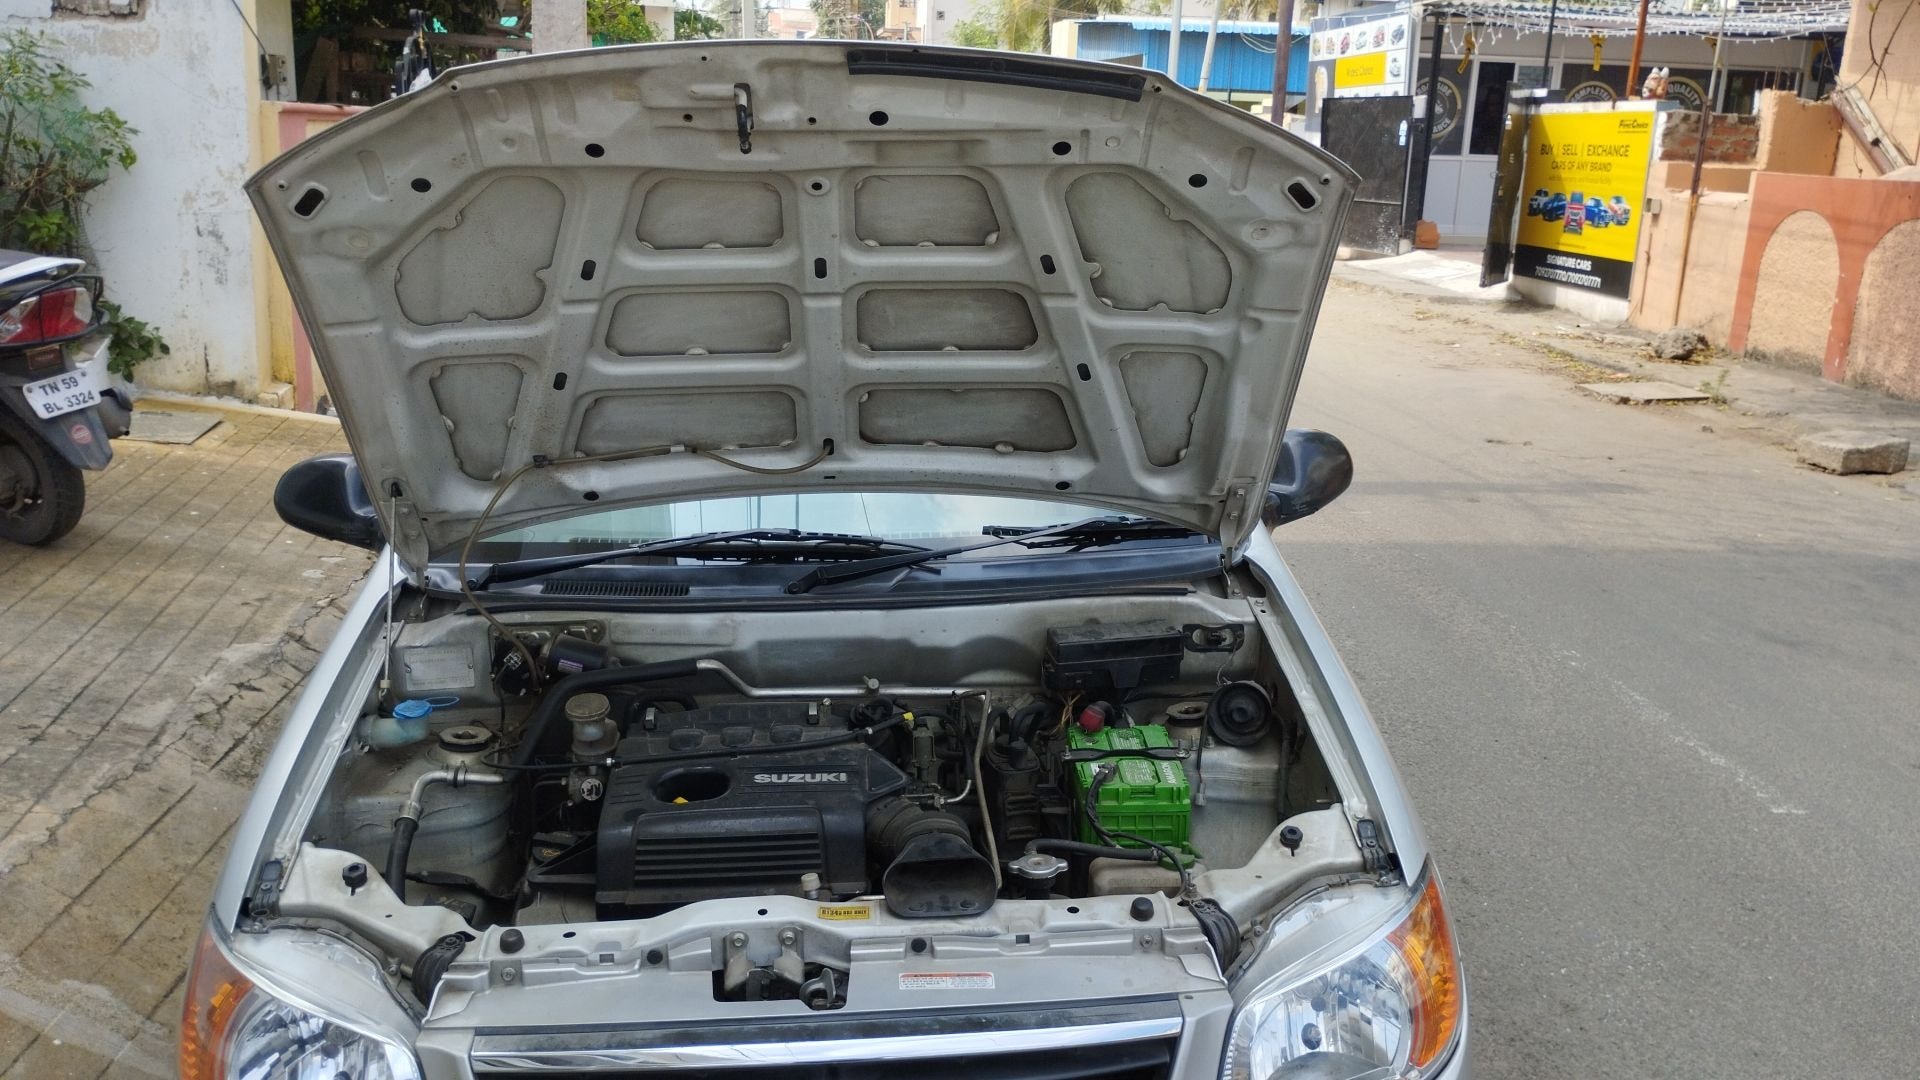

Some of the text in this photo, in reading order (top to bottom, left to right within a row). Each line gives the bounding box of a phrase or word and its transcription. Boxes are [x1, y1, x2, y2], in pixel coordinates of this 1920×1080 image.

[1540, 143, 1630, 157] BUY SELL EXCHANGE
[1551, 160, 1612, 172] CARS OF ANY BRAND
[1546, 254, 1592, 271] SIGNATURE CARS
[39, 376, 79, 396] TN 59
[43, 390, 95, 414] BL 3324
[753, 772, 847, 783] SUZUKI
